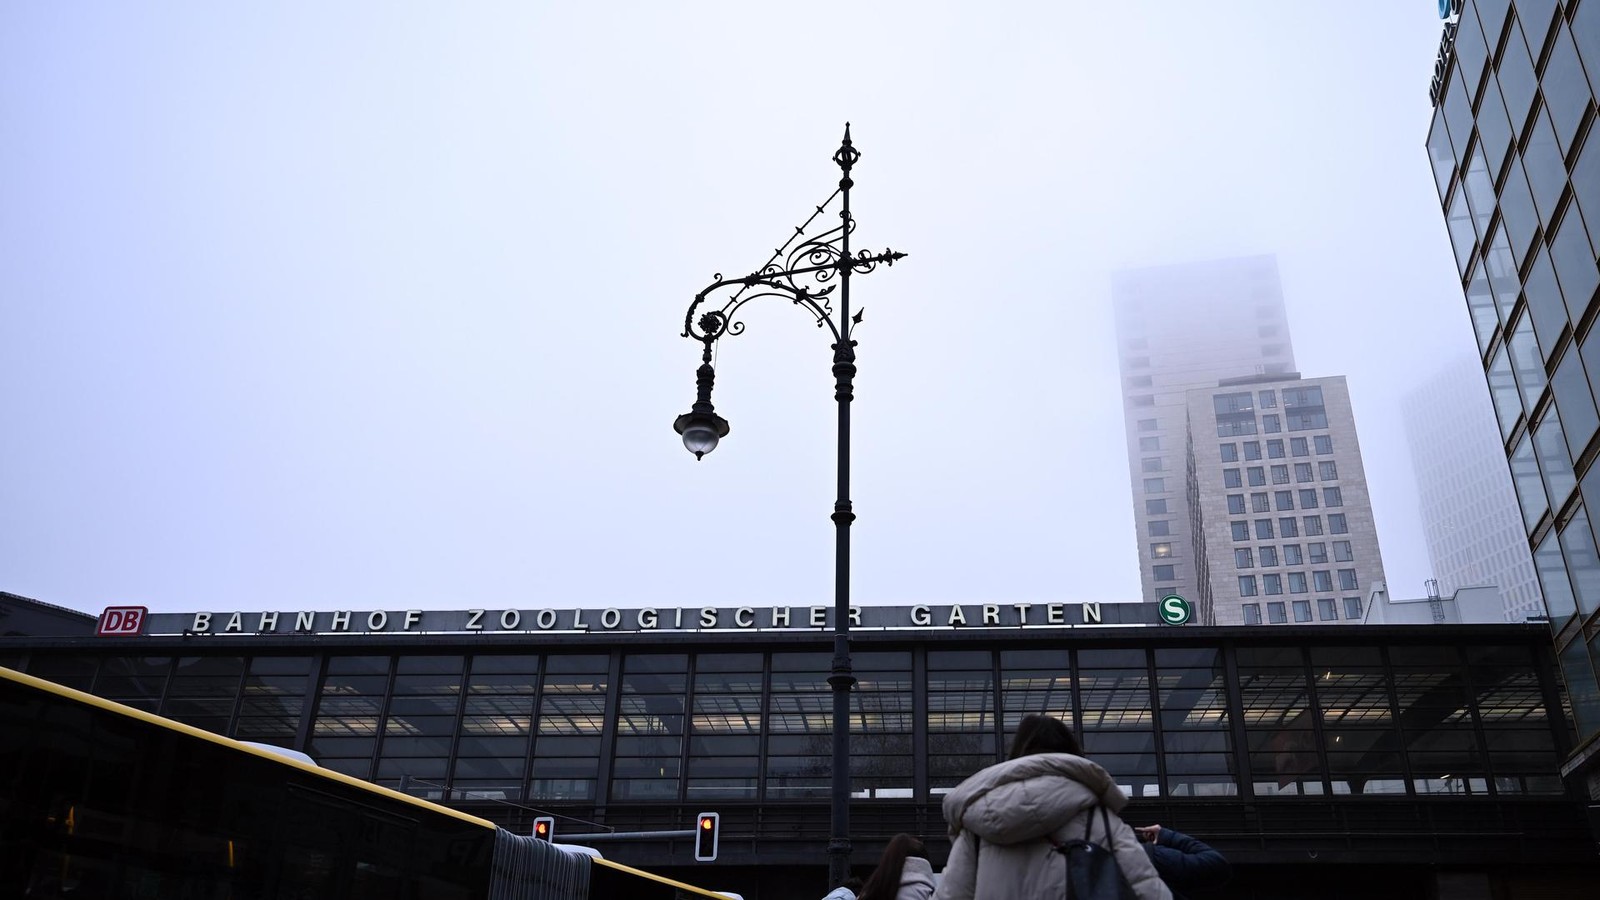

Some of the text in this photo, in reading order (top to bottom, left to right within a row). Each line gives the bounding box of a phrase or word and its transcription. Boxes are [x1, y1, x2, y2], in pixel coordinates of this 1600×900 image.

[104, 611, 140, 631] DB
[191, 602, 1102, 631] BAHNHOF ZOOLOGISCHER GARTEN
[1164, 598, 1186, 621] S
